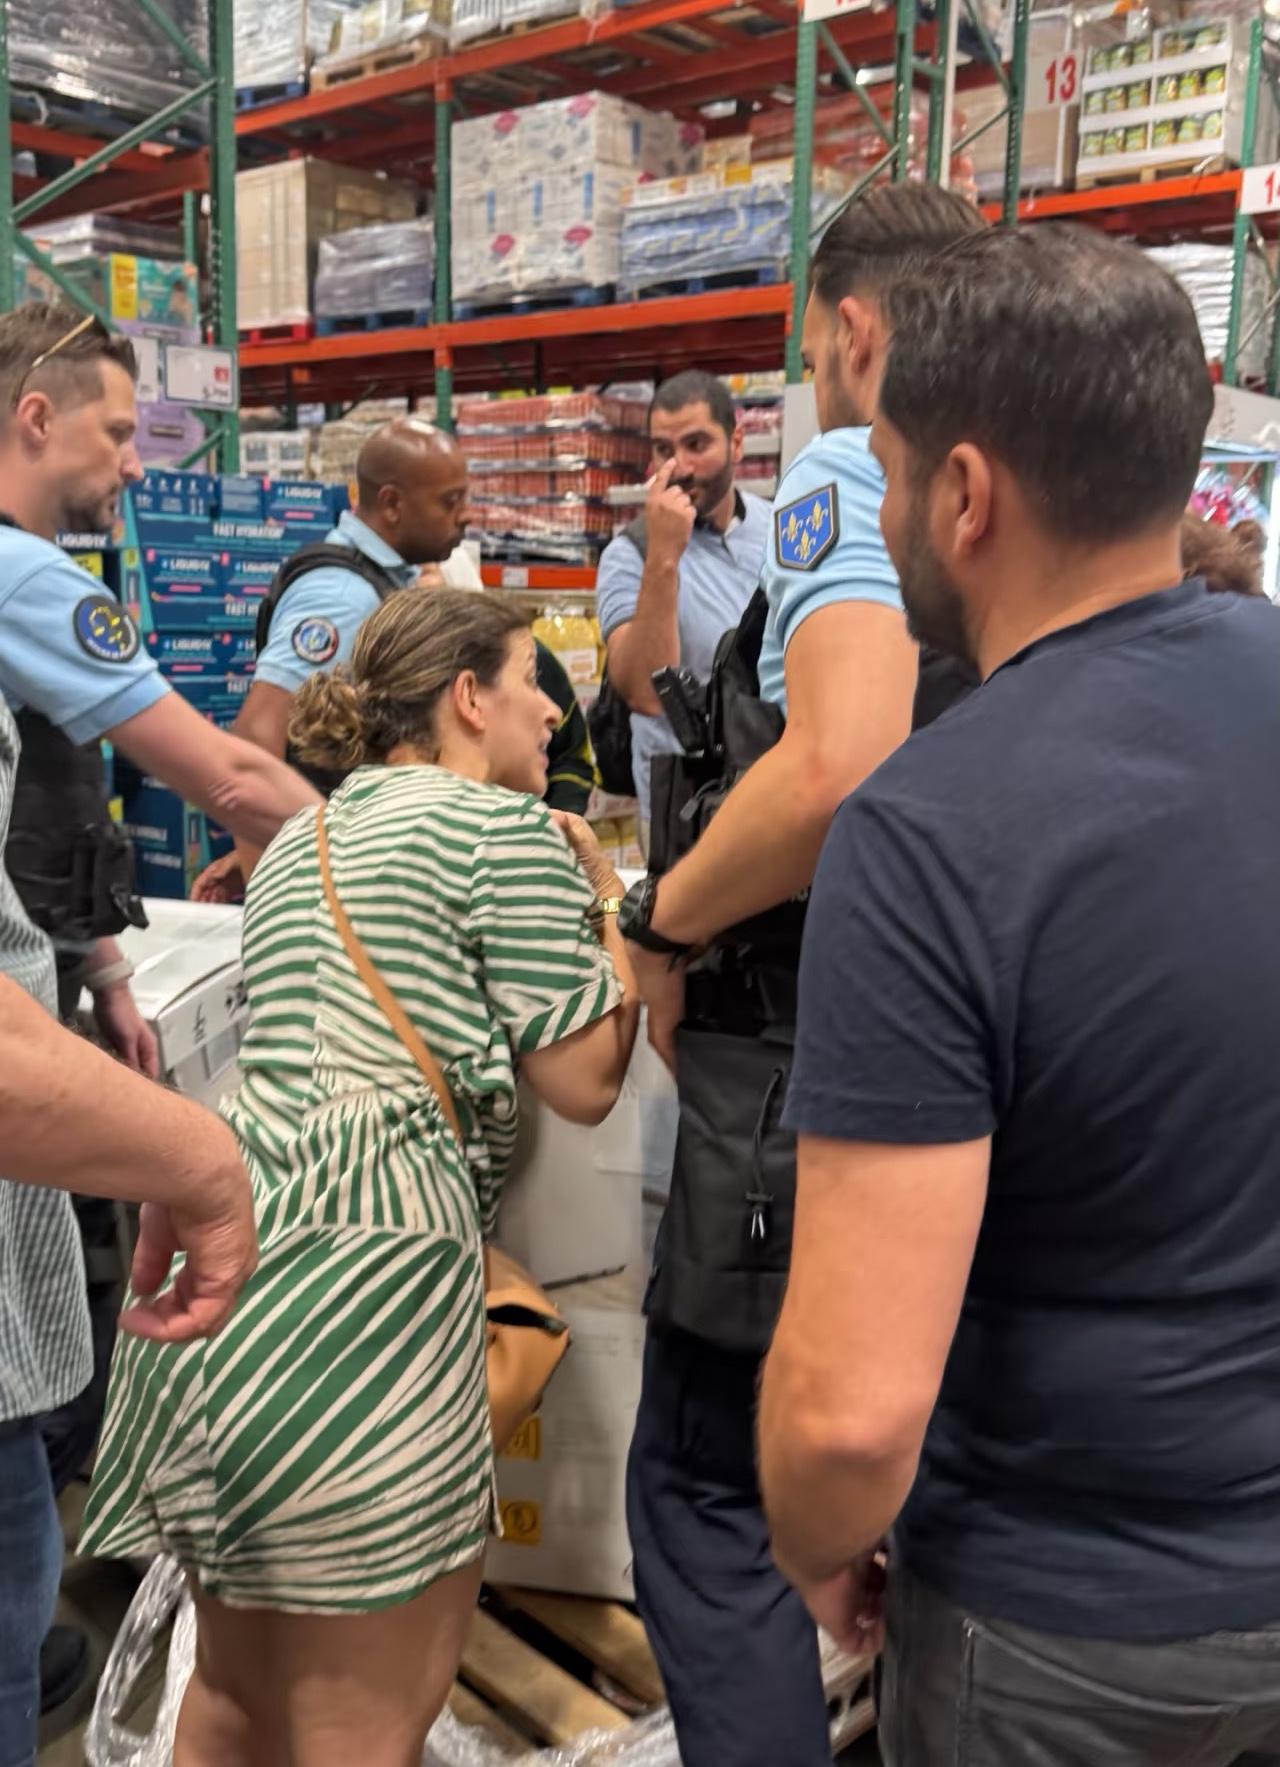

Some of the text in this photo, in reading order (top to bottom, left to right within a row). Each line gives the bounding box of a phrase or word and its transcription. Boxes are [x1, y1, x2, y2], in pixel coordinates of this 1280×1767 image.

[1045, 55, 1076, 104] 13
[1264, 170, 1280, 205] 1
[213, 522, 235, 536] FAST
[225, 602, 246, 616] FAST
